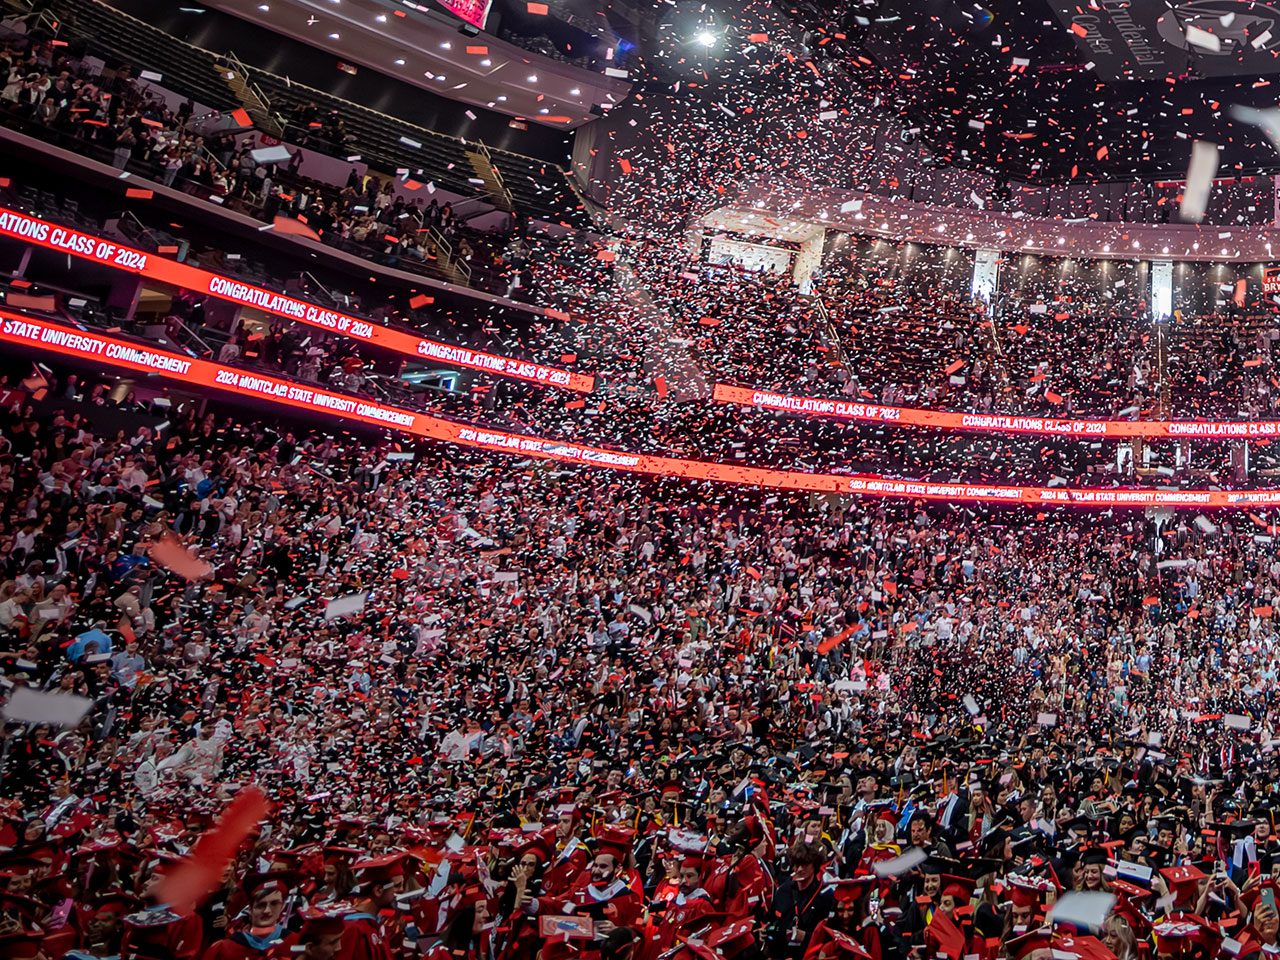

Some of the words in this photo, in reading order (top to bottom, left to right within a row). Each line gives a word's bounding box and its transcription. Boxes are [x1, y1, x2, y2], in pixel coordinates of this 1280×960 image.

[50, 228, 96, 255] CLASS
[95, 242, 116, 261] OF
[114, 248, 148, 270] 2024
[209, 276, 306, 319] CONGRATULATIONS
[306, 306, 337, 328] CLASS
[337, 316, 352, 332] OF
[351, 320, 374, 339] 2024
[3, 319, 42, 340] STATE
[41, 329, 107, 355] UNIVERSITY
[106, 343, 192, 375] COMMENCEMENT
[418, 340, 507, 372] CONGRATULATIONS
[215, 370, 238, 385] 2024
[238, 375, 287, 398] MONTCLAIR
[287, 387, 313, 403] STATE
[313, 392, 357, 414] UNIVERSITY
[753, 392, 834, 413] CONGRATULATIONS
[835, 402, 865, 416] CLASS
[865, 405, 879, 418] OF
[962, 415, 1042, 431] CONGRATULATIONS
[1073, 422, 1085, 432] OF
[1085, 422, 1107, 433] 2024
[1168, 423, 1247, 434] CONGRATULATIONS
[1248, 423, 1275, 434] CLASS
[906, 484, 926, 494] STATE
[1095, 492, 1116, 501] STATE
[1116, 492, 1154, 502] UNIVERSITY
[1155, 493, 1210, 503] COMMENCEMENT
